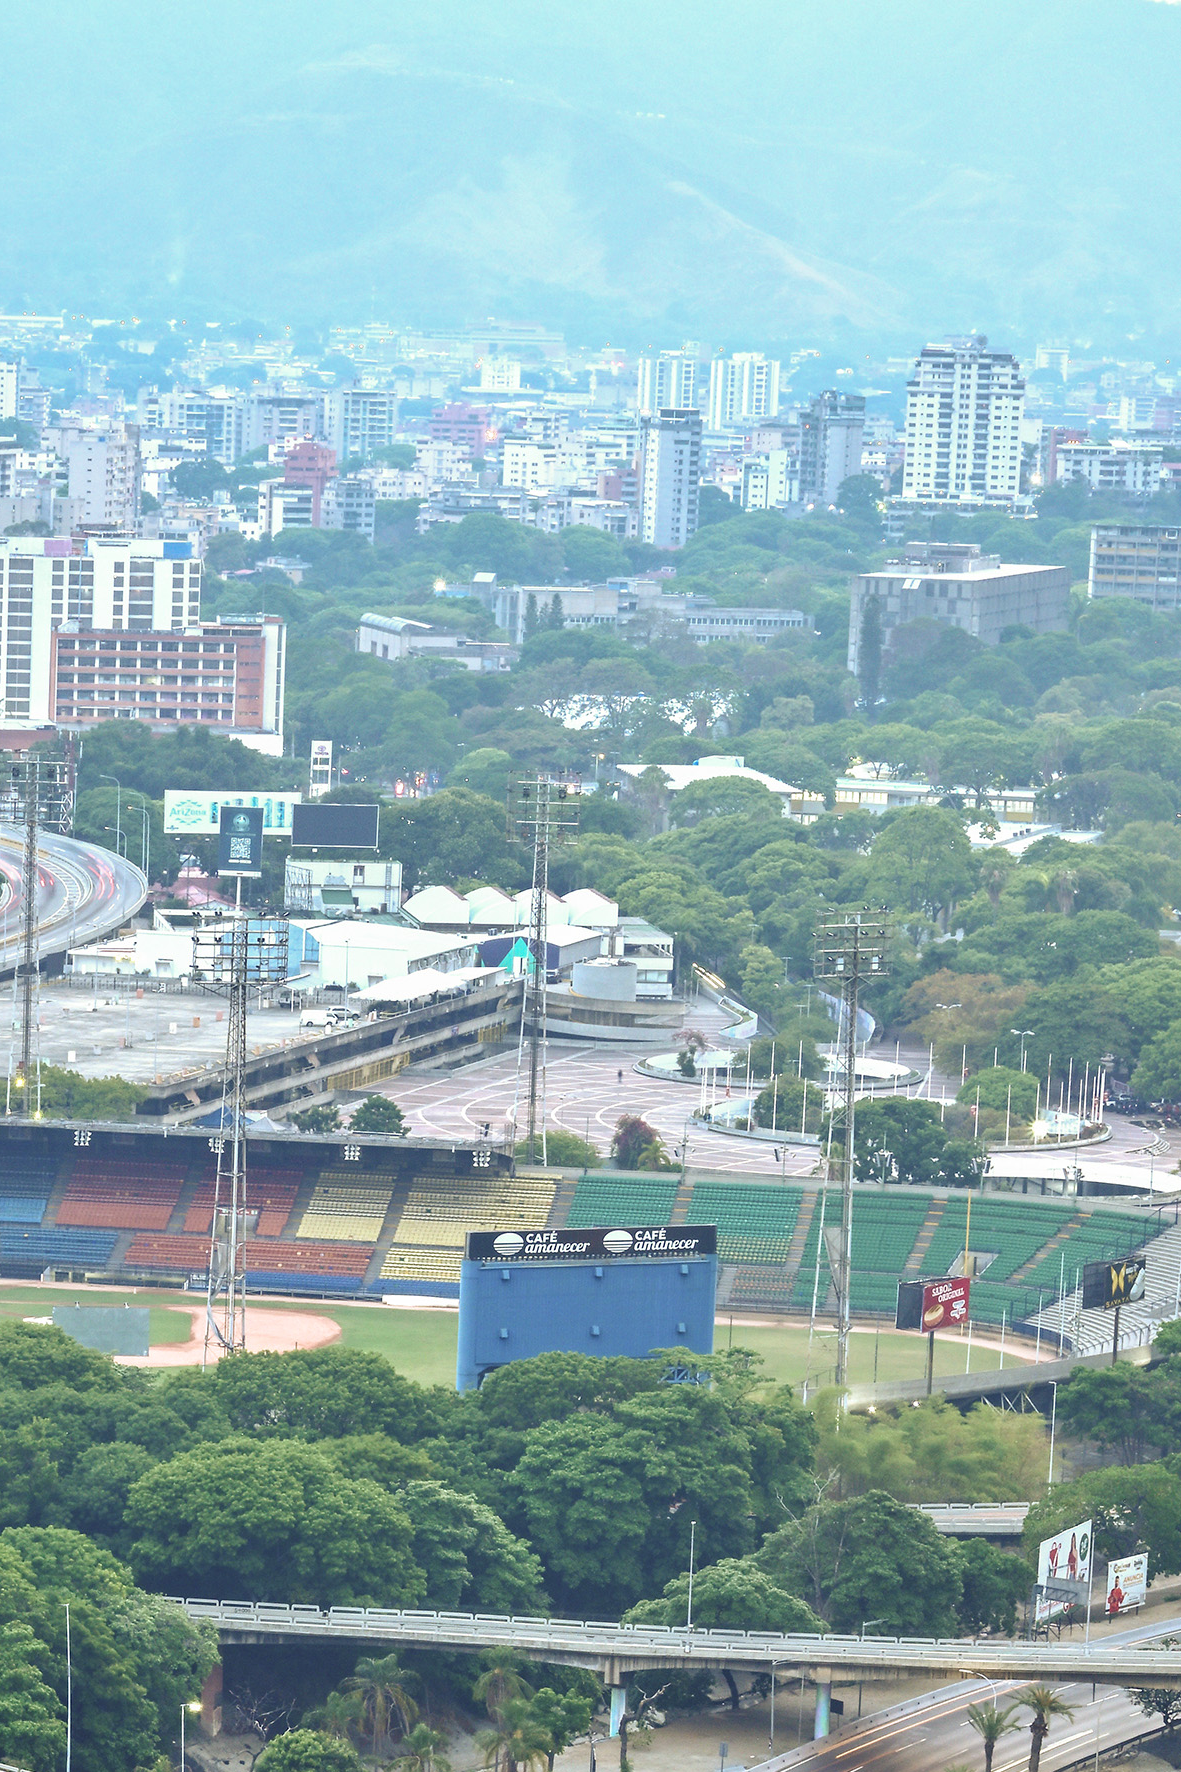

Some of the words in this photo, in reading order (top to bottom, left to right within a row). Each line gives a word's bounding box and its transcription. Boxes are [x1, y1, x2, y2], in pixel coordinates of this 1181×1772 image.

[525, 1231, 558, 1243] CAFÉ
[634, 1228, 667, 1240] CAFÉ
[524, 1242, 591, 1254] amanecer
[633, 1239, 699, 1251] amanecer
[937, 1287, 965, 1303] ORIGINAL
